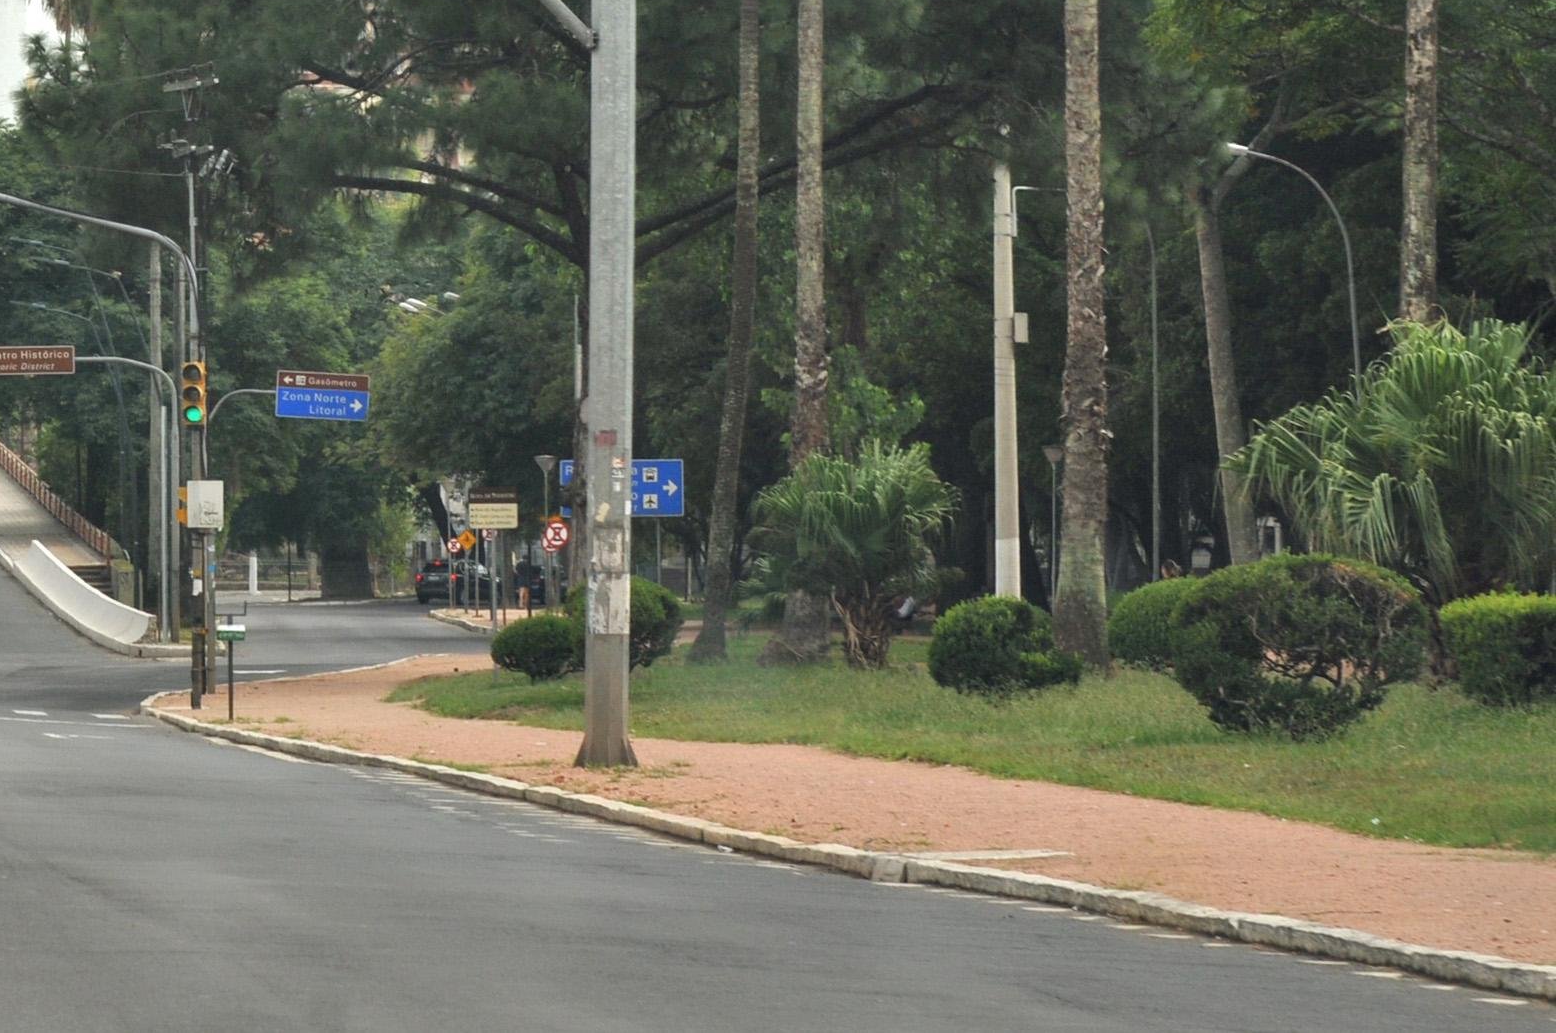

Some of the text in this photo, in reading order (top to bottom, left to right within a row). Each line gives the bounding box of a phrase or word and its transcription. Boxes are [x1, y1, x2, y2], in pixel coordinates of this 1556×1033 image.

[20, 349, 70, 360] Histórico
[20, 362, 55, 371] District
[308, 376, 357, 388] Gasômetro
[282, 390, 347, 404] Zona Norte
[309, 405, 346, 416] Litoral
